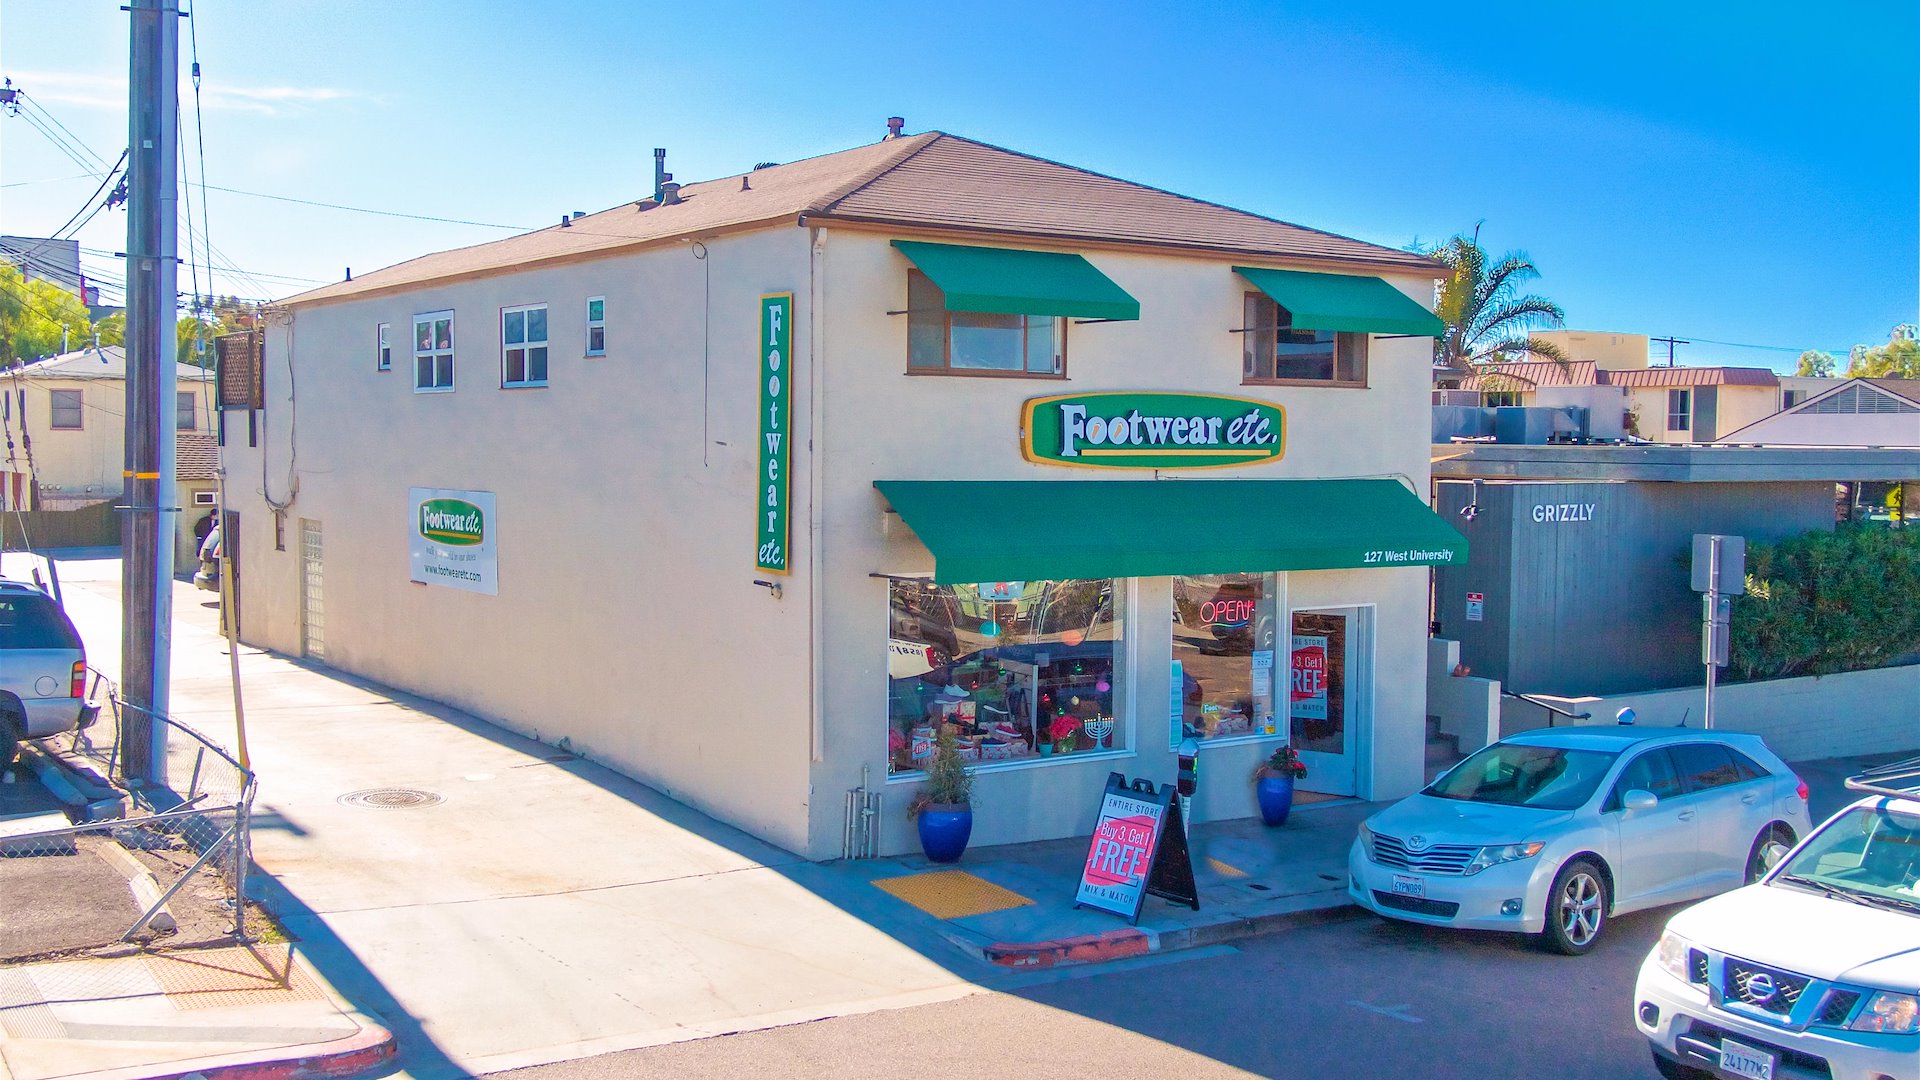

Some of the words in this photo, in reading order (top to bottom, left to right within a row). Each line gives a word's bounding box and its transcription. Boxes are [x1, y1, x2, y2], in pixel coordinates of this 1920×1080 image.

[764, 304, 783, 533] Footwear
[1059, 403, 1223, 457] Footwear
[1226, 408, 1278, 445] etc.
[422, 505, 465, 534] Footwear
[465, 510, 482, 534] etc.
[1532, 503, 1595, 523] GRIZZLY
[758, 538, 785, 566] etc.
[1363, 551, 1383, 563] 127
[1385, 550, 1407, 562] West
[1409, 548, 1454, 562] University
[423, 563, 482, 583] www.footwearetc.com
[1200, 600, 1251, 622] OPEN
[1304, 656, 1318, 668] Get
[1291, 668, 1323, 693] REE
[1302, 703, 1325, 711] MATCH
[1108, 798, 1133, 813] ENTIRE
[1135, 804, 1159, 818] STORE
[1100, 821, 1119, 840] Buy
[1128, 828, 1146, 846] Get
[1090, 838, 1147, 880] FREE
[1084, 884, 1098, 895] MIX
[1108, 890, 1135, 905] MATCH
